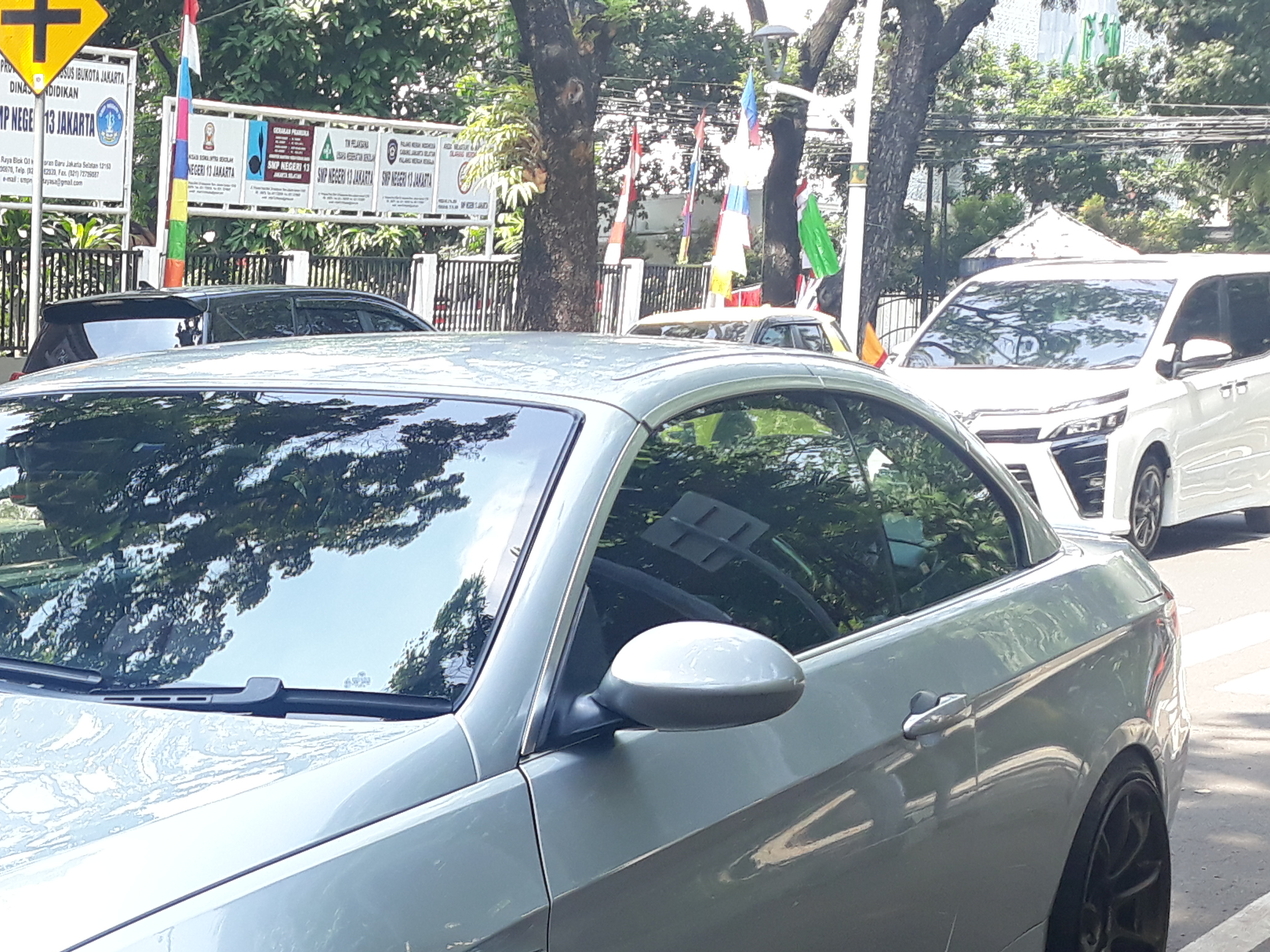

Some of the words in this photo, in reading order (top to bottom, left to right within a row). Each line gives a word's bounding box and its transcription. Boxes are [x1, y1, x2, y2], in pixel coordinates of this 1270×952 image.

[75, 67, 99, 82] IBUKOTA
[101, 70, 124, 84] JAKARTA
[56, 111, 95, 137] JAKARTA
[212, 165, 235, 178] JAKARTA
[281, 161, 302, 172] NEGERI
